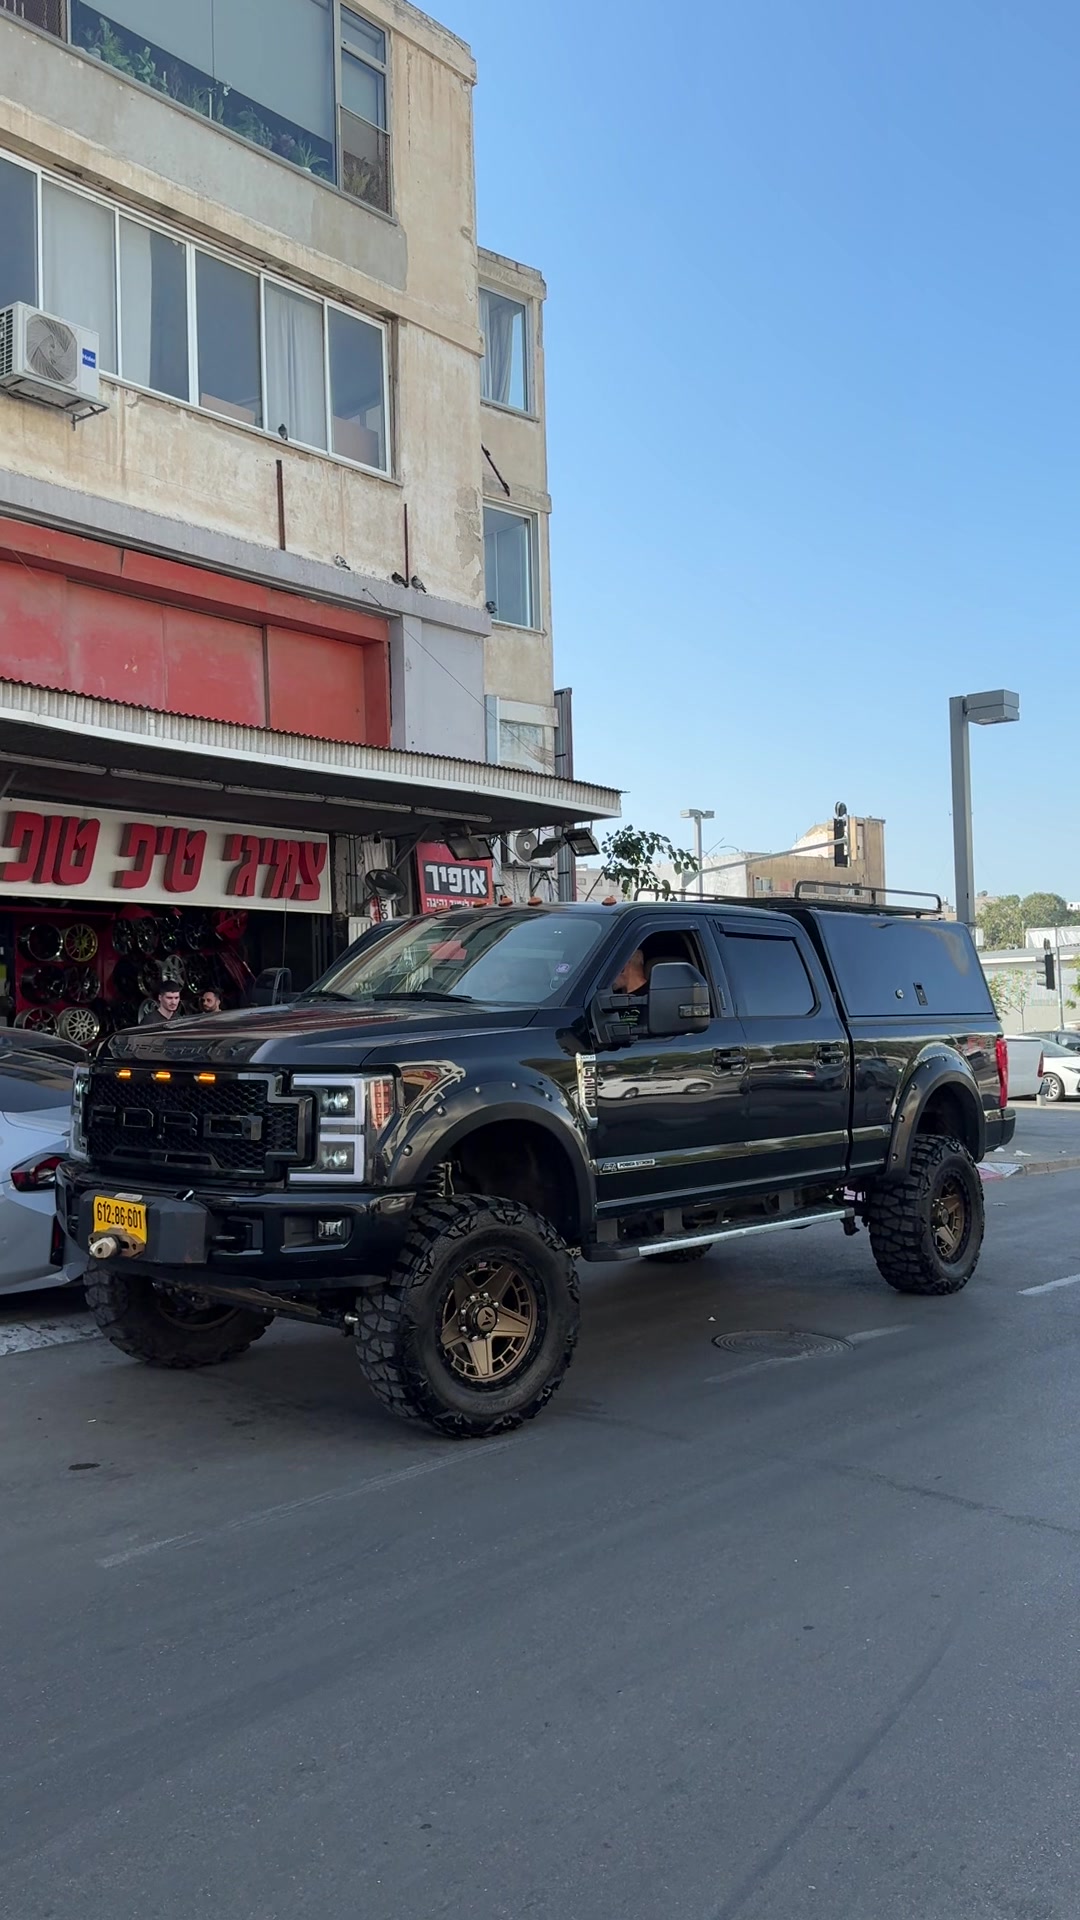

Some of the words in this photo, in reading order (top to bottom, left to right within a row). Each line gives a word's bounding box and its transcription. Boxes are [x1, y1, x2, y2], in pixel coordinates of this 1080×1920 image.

[0, 811, 100, 885] טופ
[114, 823, 207, 892] טיפ
[223, 834, 327, 900] צמיגי
[425, 865, 487, 895] אופיר
[89, 1104, 263, 1141] FORD
